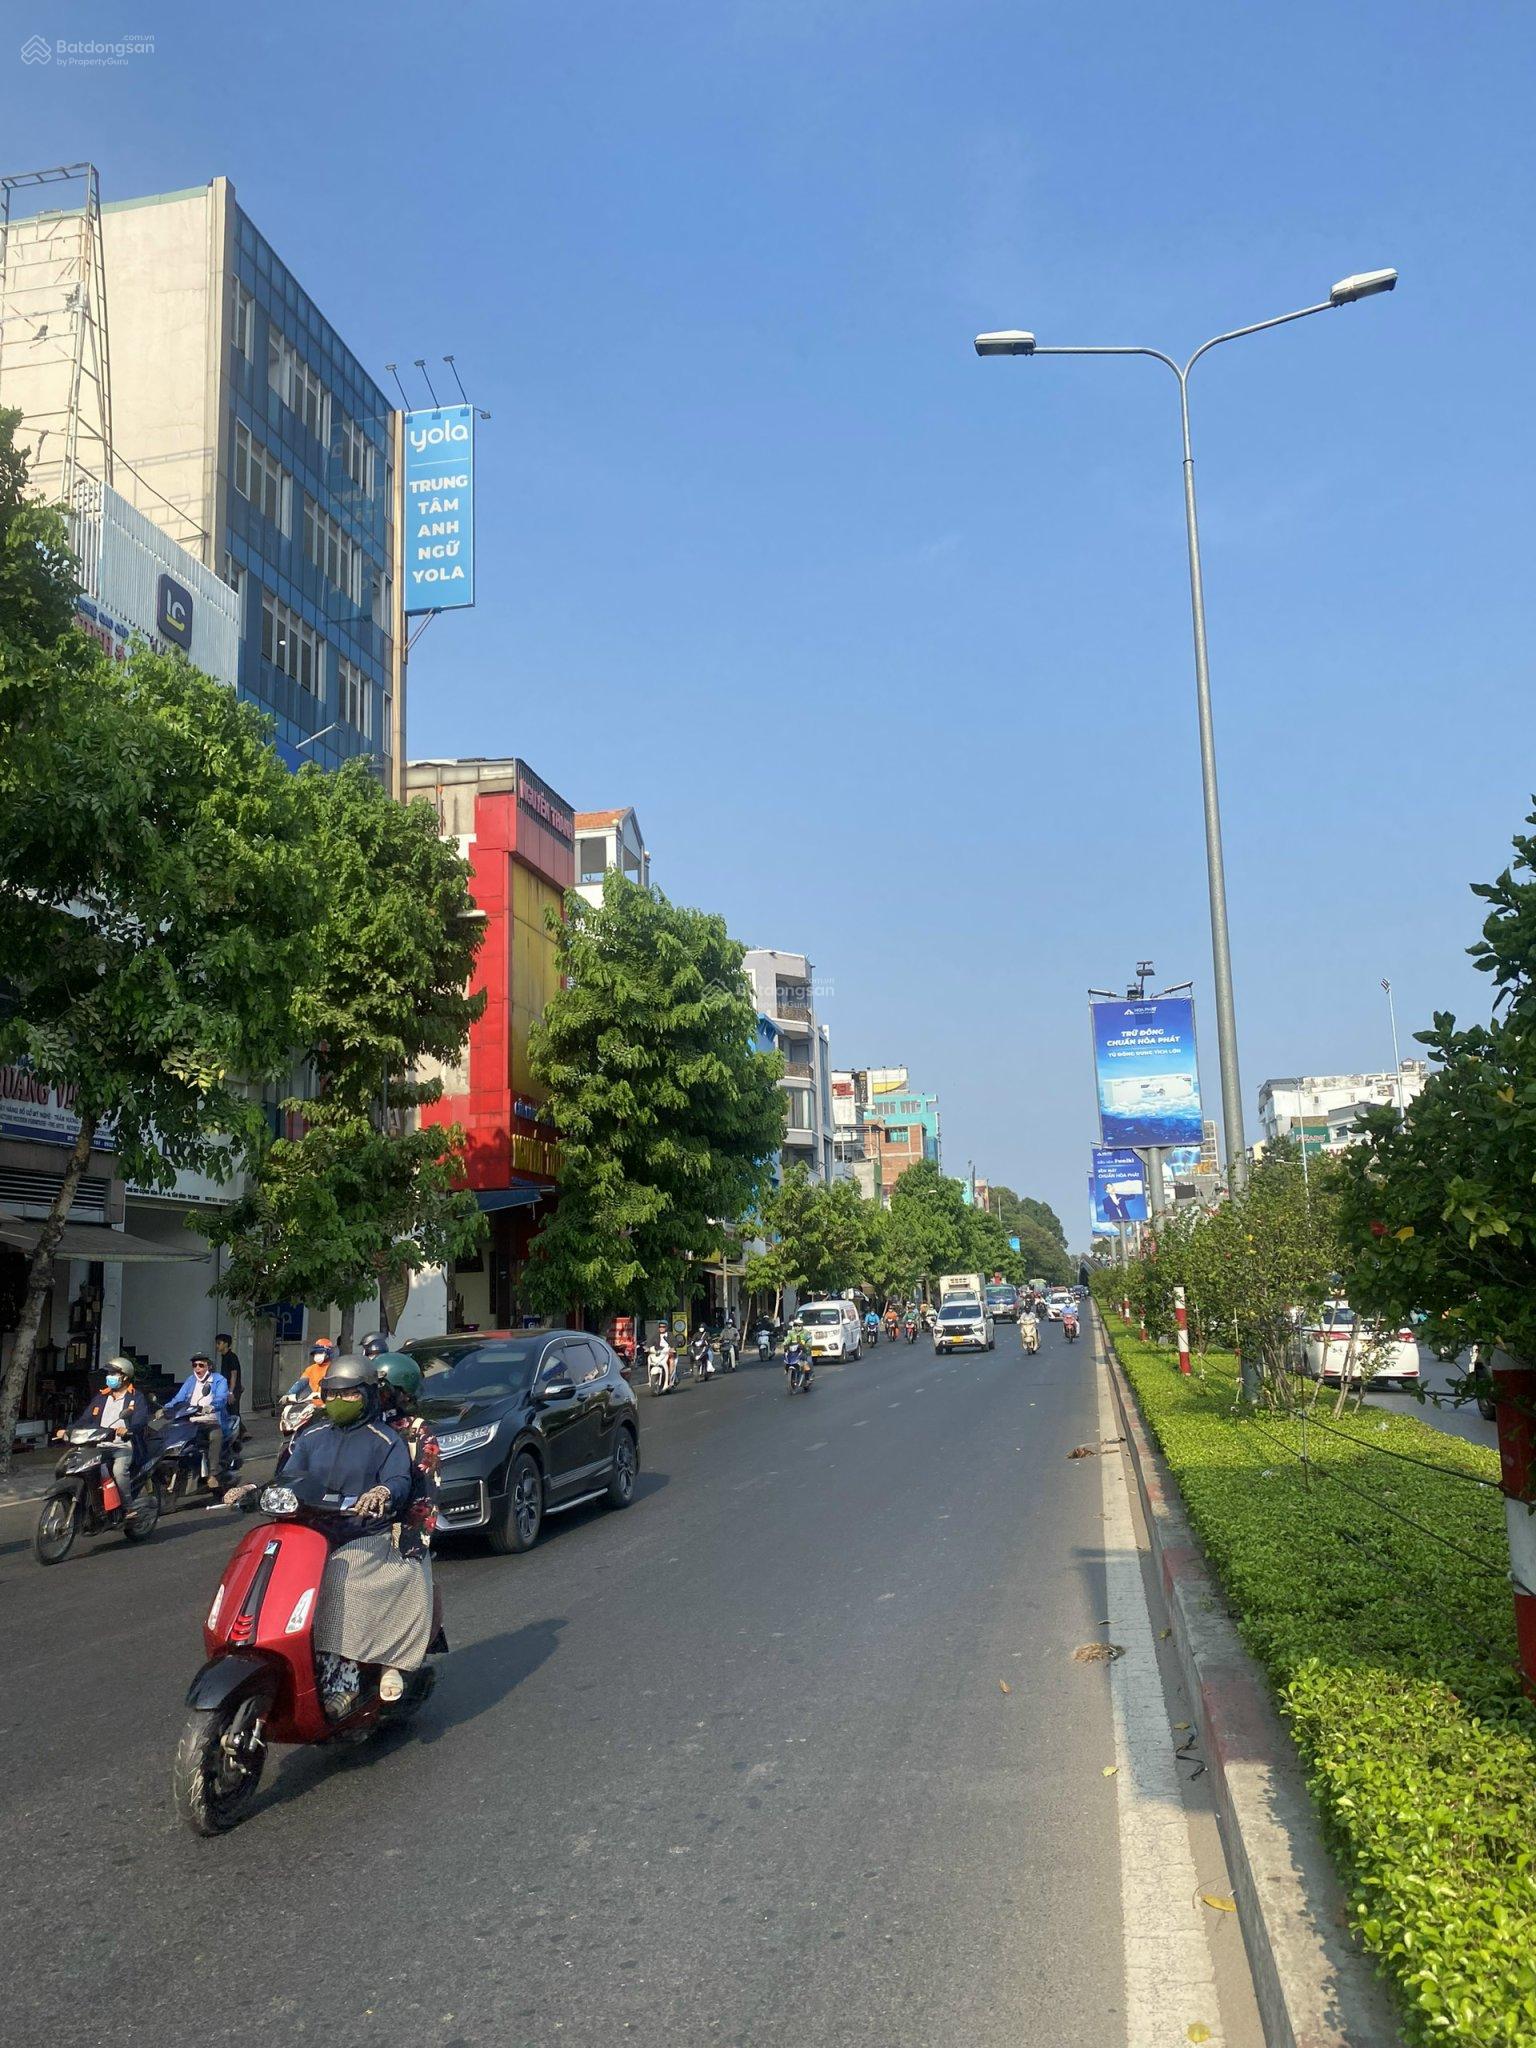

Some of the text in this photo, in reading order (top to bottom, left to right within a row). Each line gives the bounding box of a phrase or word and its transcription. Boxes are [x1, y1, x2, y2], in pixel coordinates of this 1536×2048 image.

[410, 419, 468, 453] yola
[409, 475, 468, 494] TRUNG
[418, 497, 459, 515] TÂM
[417, 520, 459, 538] ANH
[418, 540, 460, 560] NGỮ
[412, 566, 465, 583] YOLA
[1121, 1028, 1164, 1037] TRỮ ĐÔNG
[1137, 1037, 1156, 1045] HÒA
[1158, 1035, 1181, 1043] PHÁT
[0, 1066, 49, 1105] UANG
